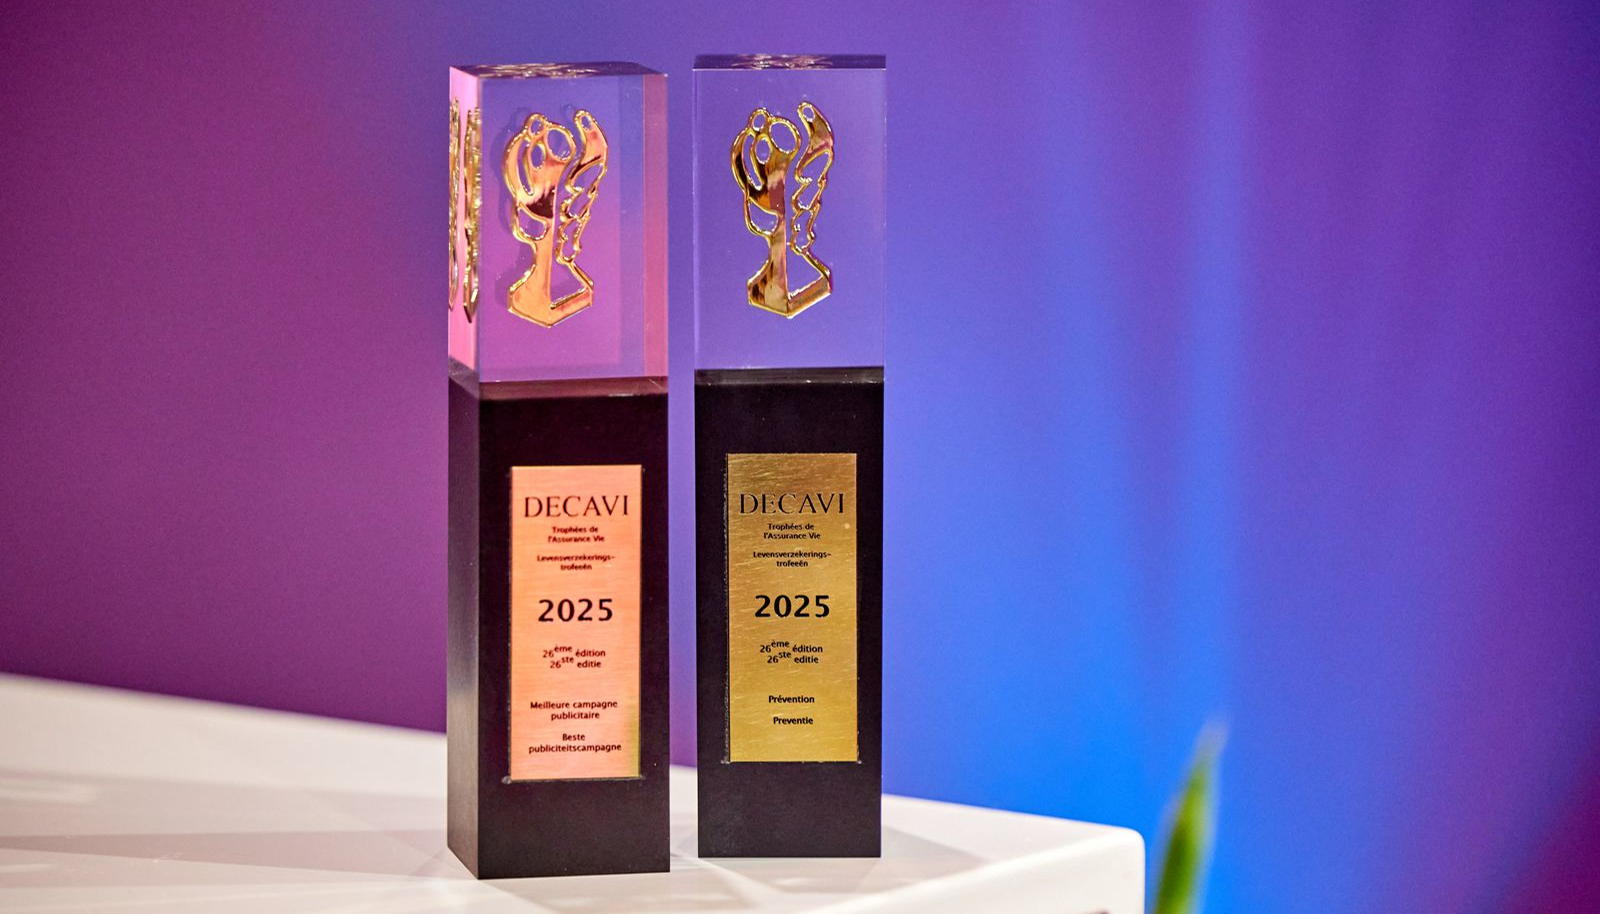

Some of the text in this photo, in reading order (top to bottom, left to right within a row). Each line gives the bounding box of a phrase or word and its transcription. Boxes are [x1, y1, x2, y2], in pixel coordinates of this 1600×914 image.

[524, 496, 628, 518] DECAVI
[739, 493, 844, 514] DECAVI
[552, 526, 587, 534] Trophées
[753, 551, 831, 559] Levensverzekerings-
[538, 598, 613, 622] 2025
[755, 594, 829, 618] 2025
[769, 695, 815, 703] Prévention
[530, 701, 618, 709] Meilleure campagne
[551, 712, 600, 721] publicitaire
[562, 733, 585, 741] Beste
[529, 744, 621, 754] publiciteitscampagne
